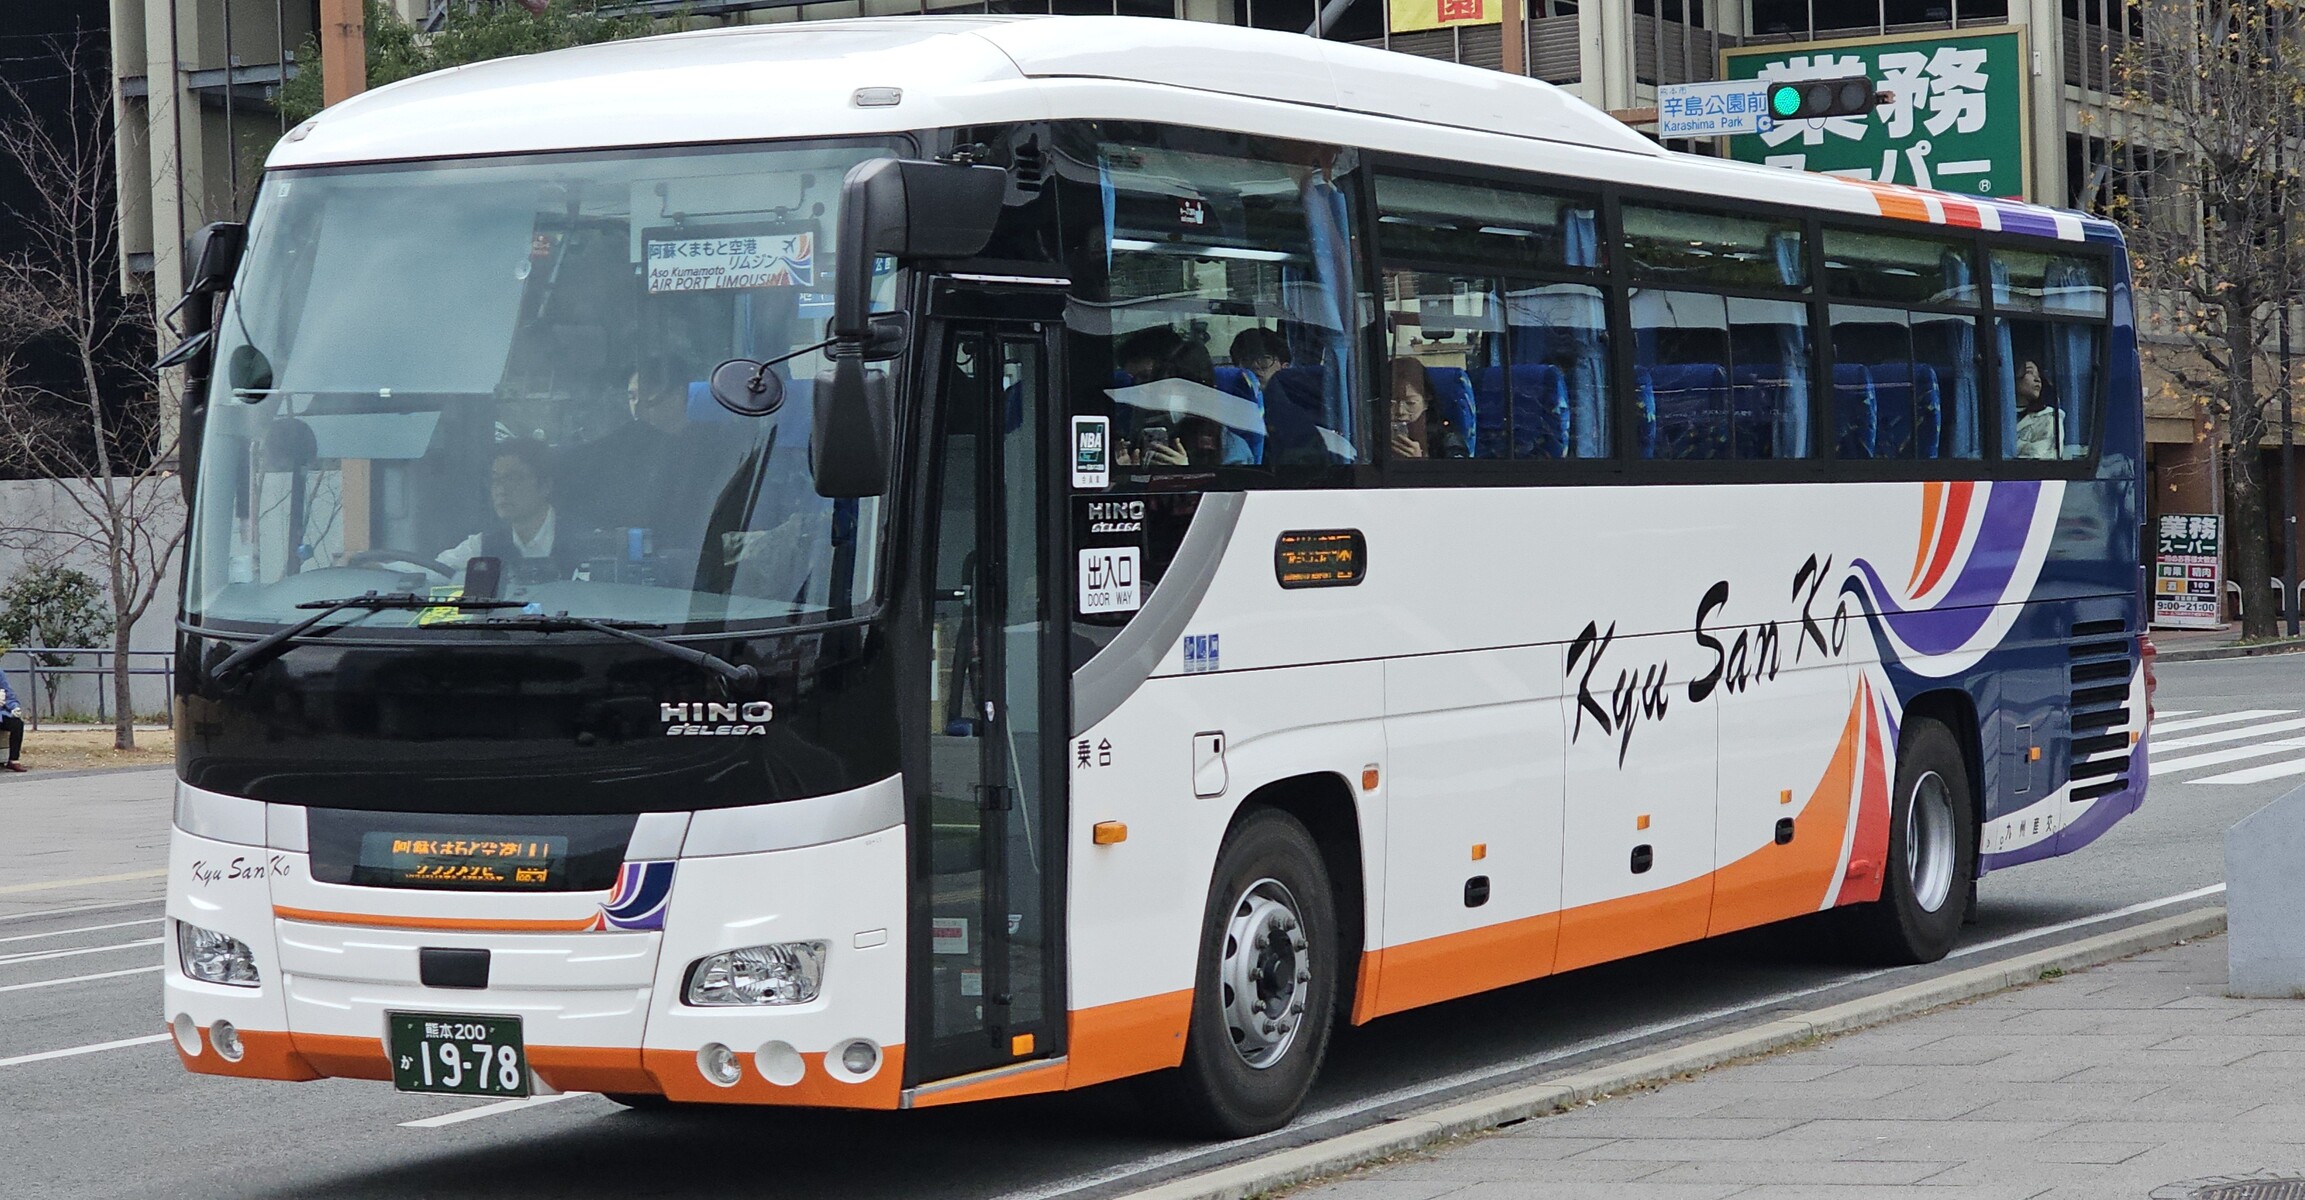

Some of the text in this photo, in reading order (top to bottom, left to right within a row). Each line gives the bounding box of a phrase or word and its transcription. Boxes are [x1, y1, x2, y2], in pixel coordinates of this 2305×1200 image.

[1664, 91, 1767, 117] 辛島公園前
[1664, 116, 1743, 132] Karashima Park
[649, 238, 757, 260] 阿蘇くまもと空港
[650, 265, 725, 278] Aso Kumamoto
[729, 253, 779, 271] リムジン
[650, 277, 671, 291] AIR
[675, 276, 710, 290] PORT
[1079, 432, 1102, 448] NBA
[1088, 500, 1145, 520] HINO
[1091, 522, 1141, 533] SELEGA
[2160, 515, 2217, 540] 業務
[2159, 539, 2217, 554] スーパー
[1087, 555, 1132, 590] 出入口
[2193, 581, 2210, 589] 100
[1087, 590, 1133, 607] DOOR WAY
[1566, 552, 1847, 771] Kyu San Ko
[660, 701, 773, 722] HINO
[666, 722, 766, 736] SELEGA
[1077, 737, 1112, 770] 乗合
[192, 855, 291, 888] Kyu San Ko
[425, 1022, 486, 1041] 熊本200
[400, 1041, 520, 1091] か 19-78
